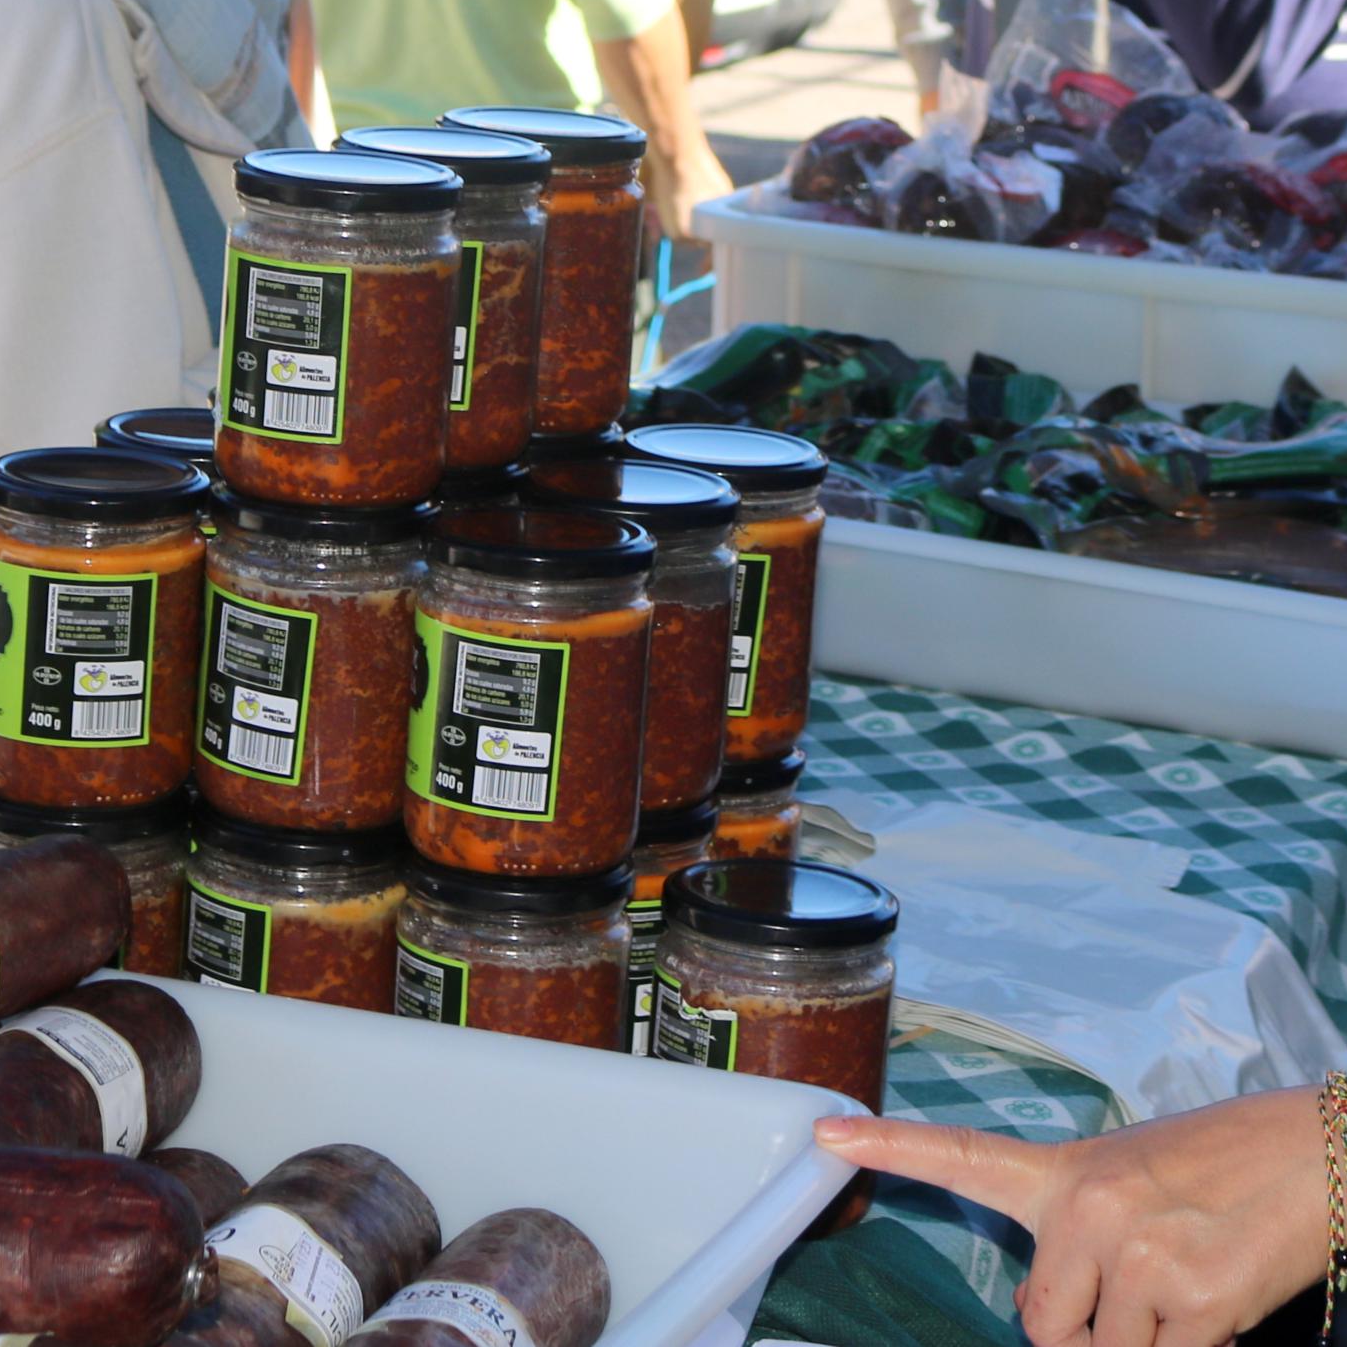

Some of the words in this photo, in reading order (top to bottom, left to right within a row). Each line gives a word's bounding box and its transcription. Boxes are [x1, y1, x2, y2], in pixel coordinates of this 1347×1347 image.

[232, 397, 249, 413] 400
[250, 406, 256, 418] g
[28, 712, 52, 727] 400
[54, 717, 61, 731] g
[435, 771, 456, 790] 400
[456, 780, 463, 794] g
